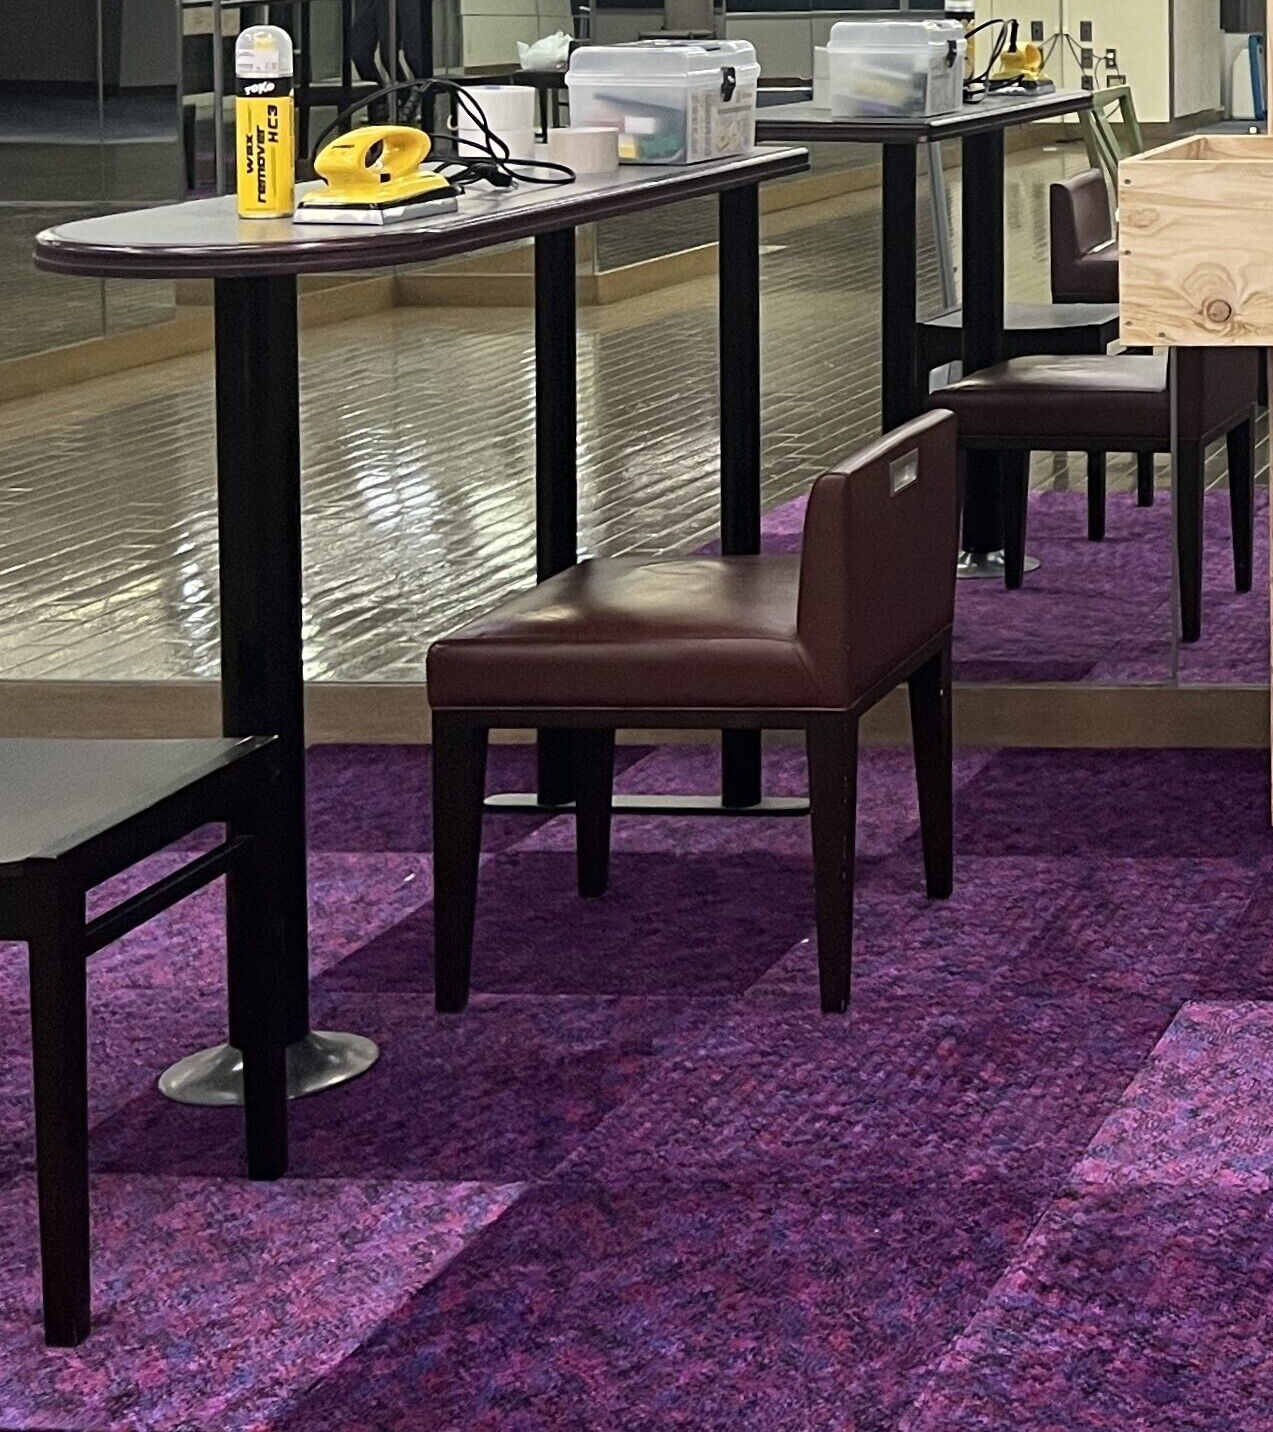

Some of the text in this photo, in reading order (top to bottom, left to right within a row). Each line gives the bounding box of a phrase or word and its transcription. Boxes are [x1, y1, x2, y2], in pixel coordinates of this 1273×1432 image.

[244, 81, 276, 96] TOKO
[267, 104, 279, 143] HC3
[245, 133, 254, 174] wax
[256, 124, 267, 204] remover
